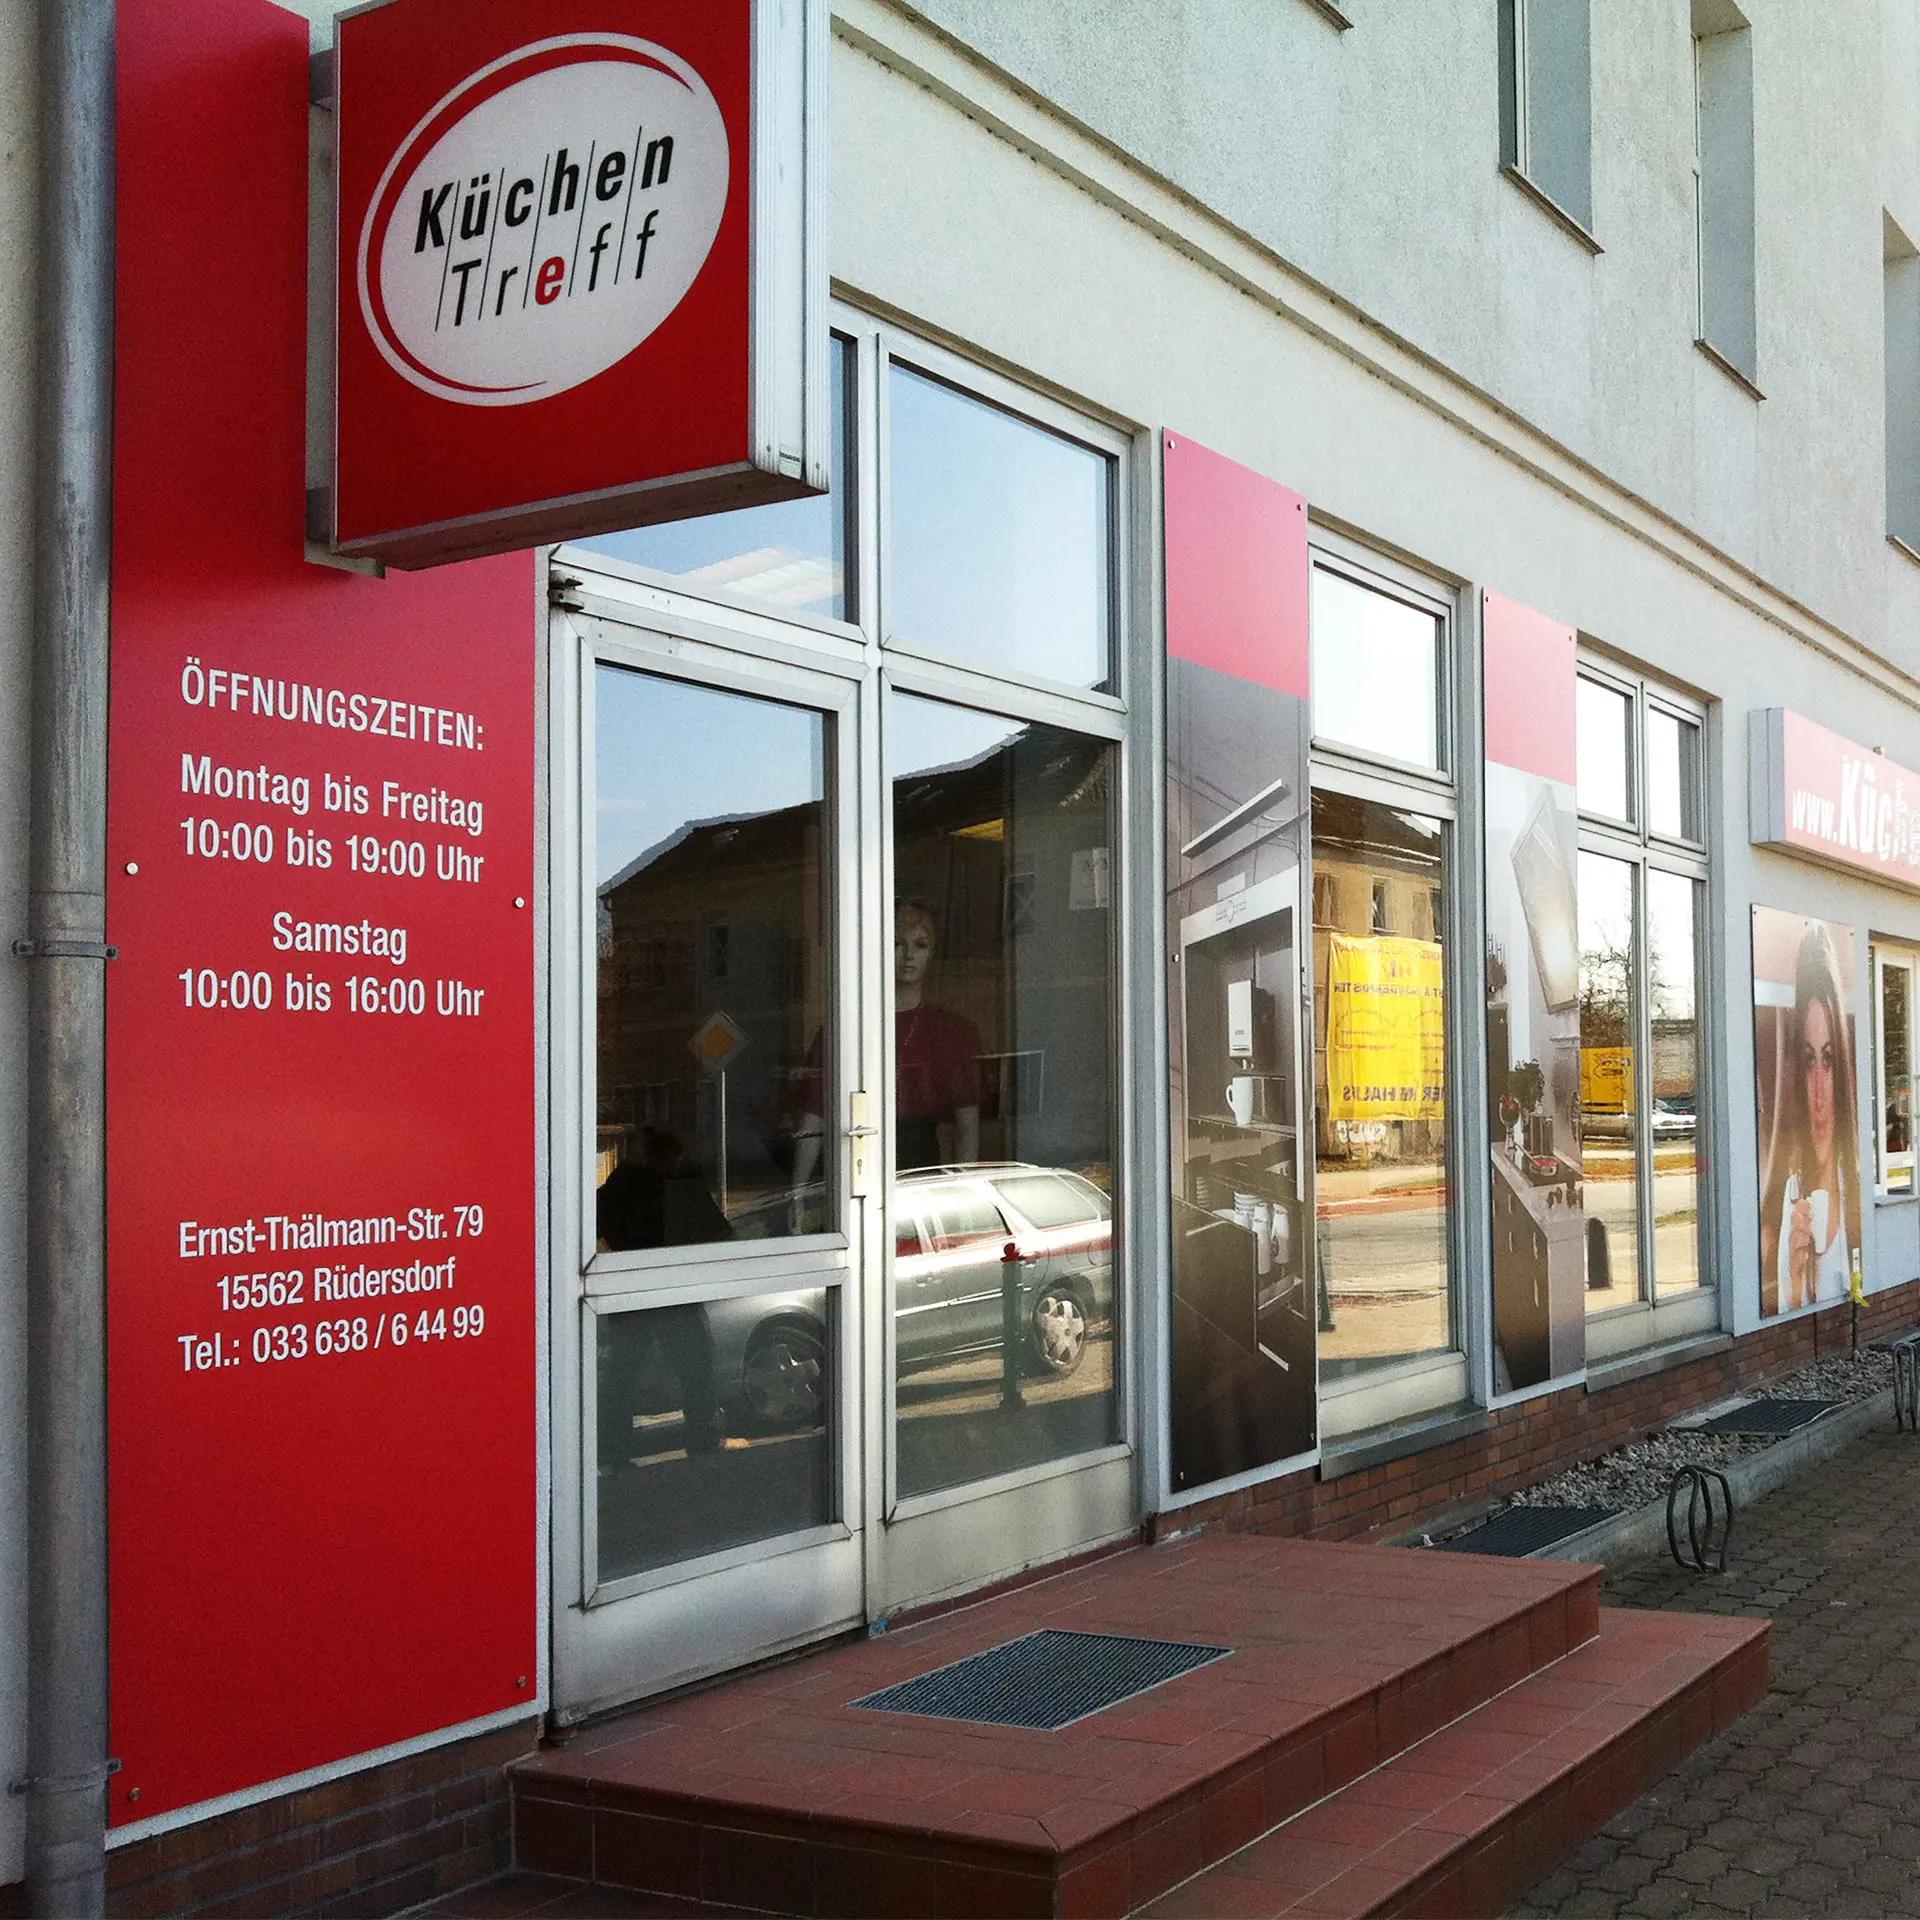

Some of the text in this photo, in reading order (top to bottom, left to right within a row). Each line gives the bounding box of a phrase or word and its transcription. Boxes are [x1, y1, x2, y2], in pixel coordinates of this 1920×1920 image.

[413, 133, 674, 254] Küchen
[451, 209, 660, 327] Treff
[181, 656, 484, 751] ÖFFNUNGSZEITEN:
[181, 753, 484, 837] Montag bis Freitag
[180, 816, 485, 883] 10:00 bis 19:00 Uhr
[272, 911, 408, 965] Samstag
[178, 968, 485, 1016] 10:00 bis 16:00 Uhr
[179, 1204, 484, 1258] Ernst-Thälmann-Str. 79
[216, 1256, 457, 1311] 15562 Rüdersdorf
[177, 1332, 241, 1372] Tel.:
[252, 1323, 308, 1363] 033
[315, 1317, 369, 1355] 638
